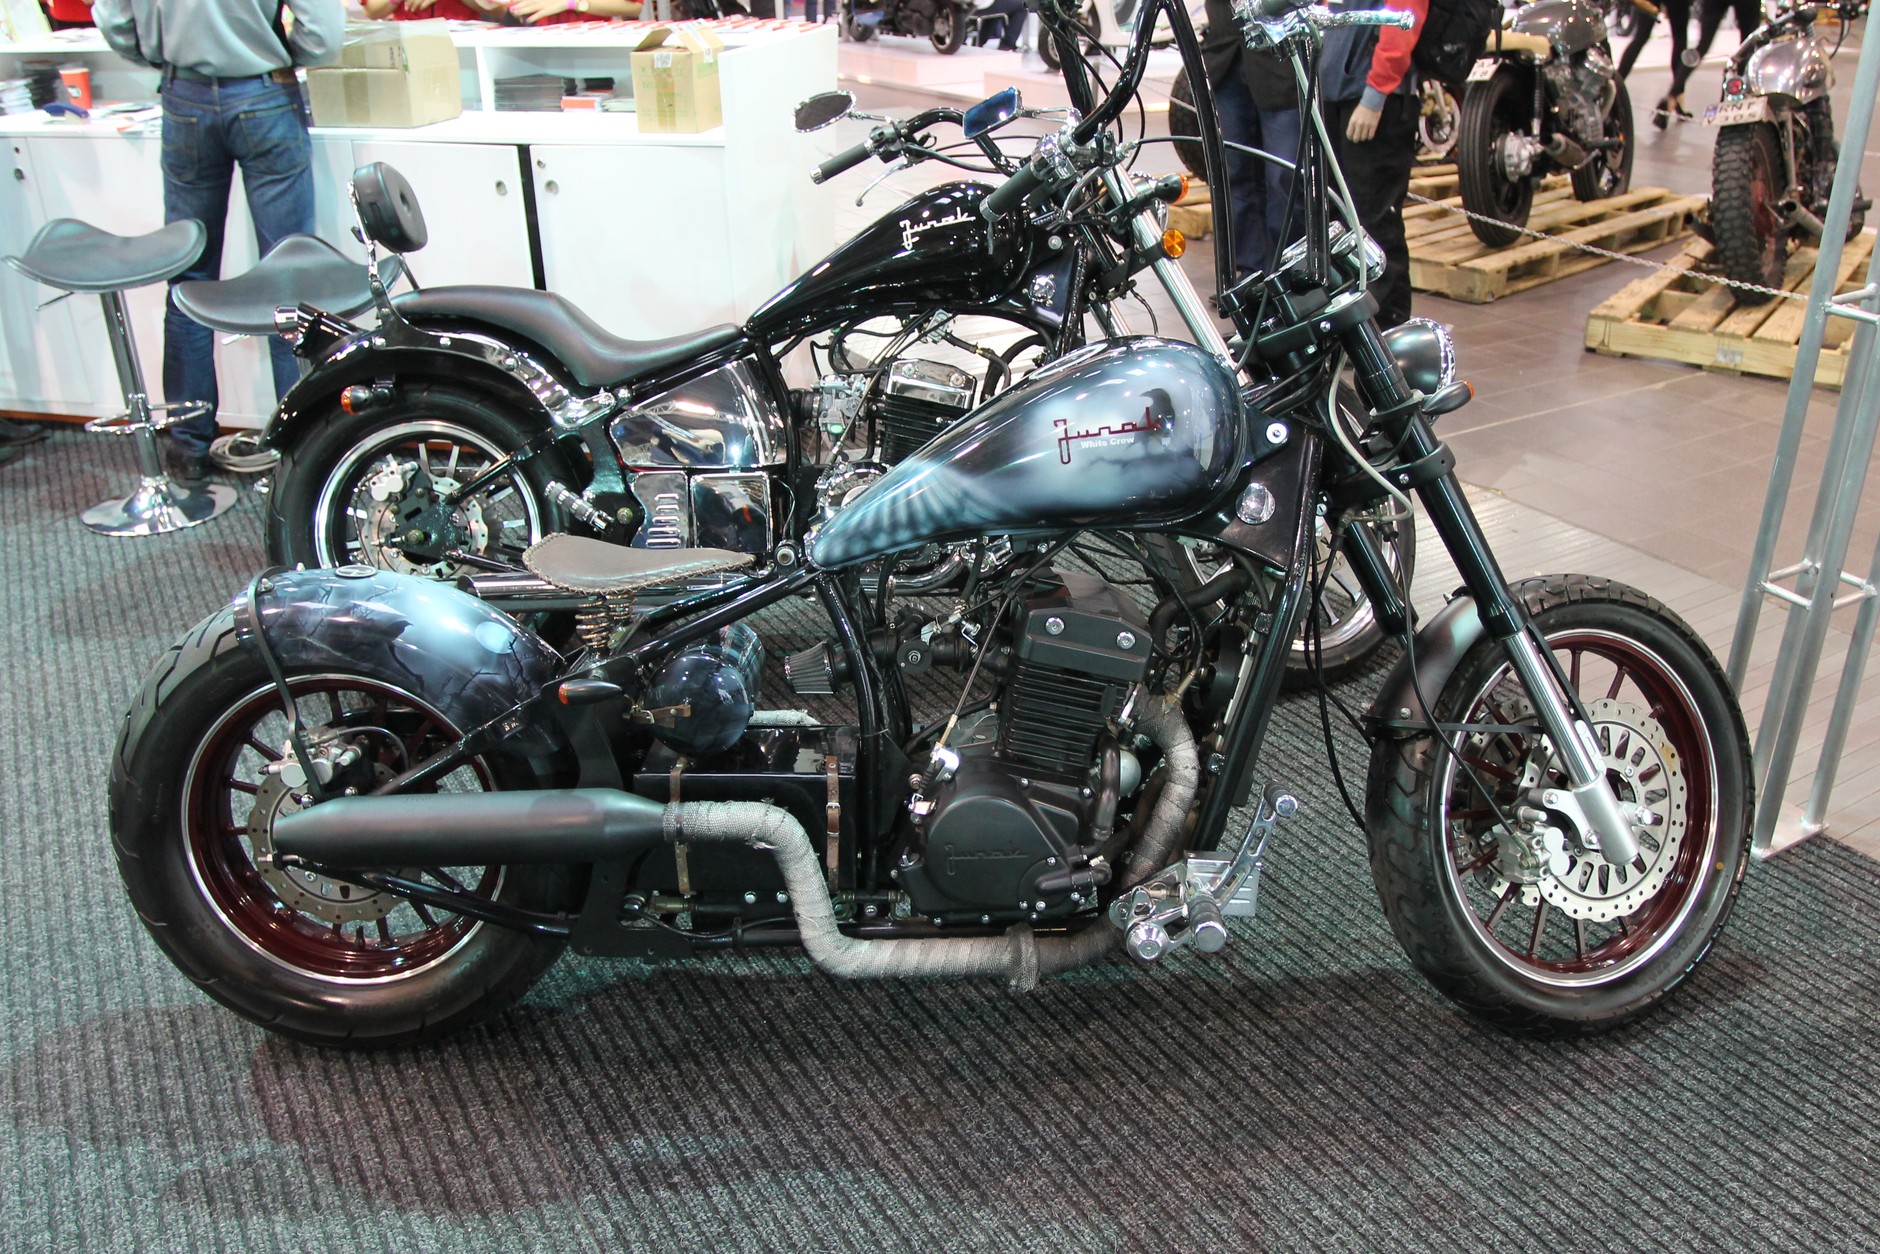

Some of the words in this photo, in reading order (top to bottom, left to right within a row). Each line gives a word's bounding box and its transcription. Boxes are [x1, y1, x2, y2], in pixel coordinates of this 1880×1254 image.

[899, 206, 976, 250] Junak
[1053, 406, 1163, 465] Junak
[1080, 440, 1108, 449] White
[1110, 437, 1135, 446] Crow
